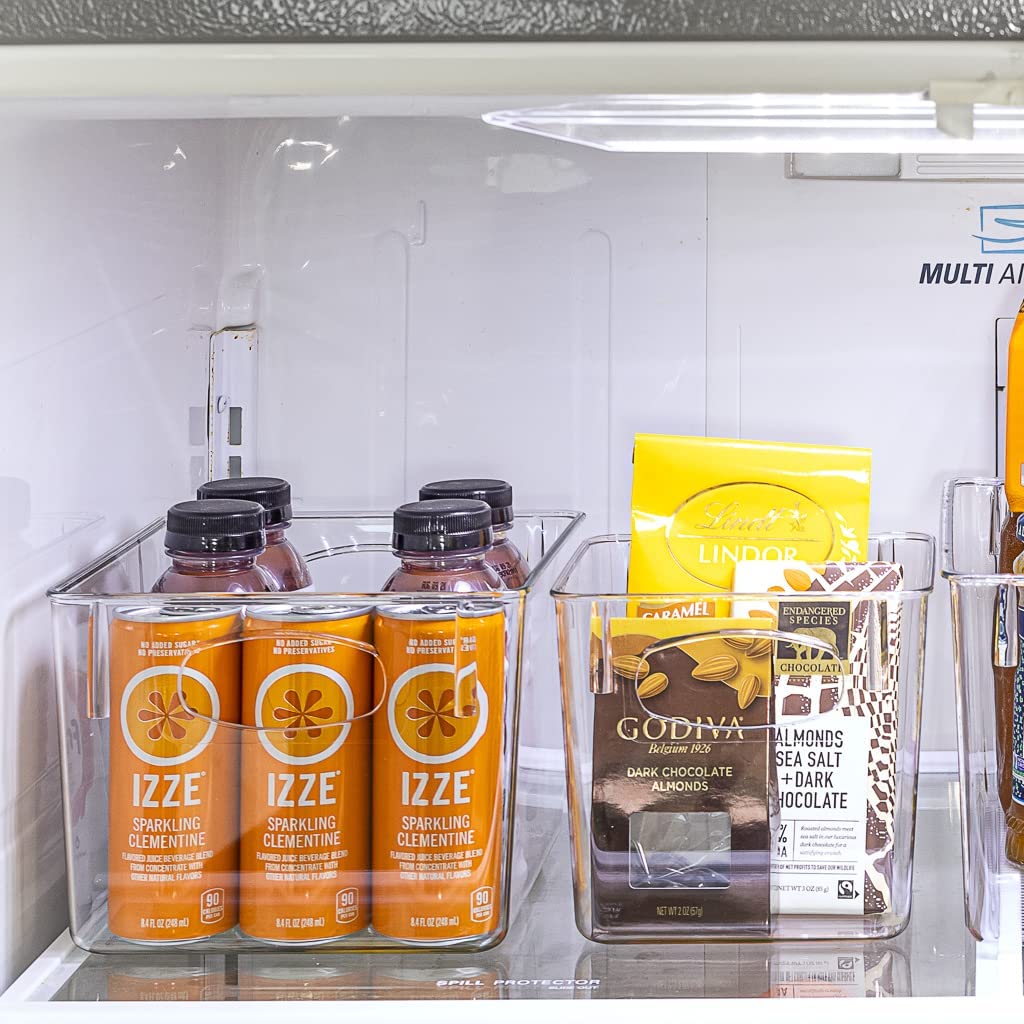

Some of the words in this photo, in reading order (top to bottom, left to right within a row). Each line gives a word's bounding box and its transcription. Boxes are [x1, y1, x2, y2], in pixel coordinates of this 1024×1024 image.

[919, 263, 993, 284] MULTI
[695, 501, 784, 532] Lindt
[698, 543, 798, 563] LINDOR
[782, 606, 846, 617] ENDANGERED
[789, 615, 839, 625] SPECIES
[148, 648, 200, 657] PRESERVATI
[616, 716, 744, 741] GODIVA
[775, 727, 844, 748] ALMONDS
[648, 743, 688, 755] Belgium
[690, 743, 712, 754] 1926
[776, 751, 802, 767] SEA
[807, 751, 842, 768] SALT
[627, 767, 659, 777] DARK
[662, 766, 733, 777] CHOCOLATE
[132, 772, 201, 808] IZZE
[267, 771, 337, 807] IZZE
[401, 770, 471, 806] IZZE
[651, 781, 709, 791] ALMONDS
[778, 791, 848, 809] HOCOLATE
[132, 816, 201, 832] SPARKLING
[267, 815, 336, 832] SPARKLING
[401, 814, 470, 831] SPARKLING
[128, 831, 206, 849] CLEMENTINE
[263, 831, 341, 848] CLEMENTINE
[397, 830, 475, 848] CLEMENTINE
[206, 892, 219, 907] 90
[341, 892, 354, 906] 90
[476, 891, 489, 905] 90
[656, 906, 667, 916] NET
[668, 906, 677, 916] WT
[677, 906, 682, 916] 2
[682, 906, 690, 916] OZ
